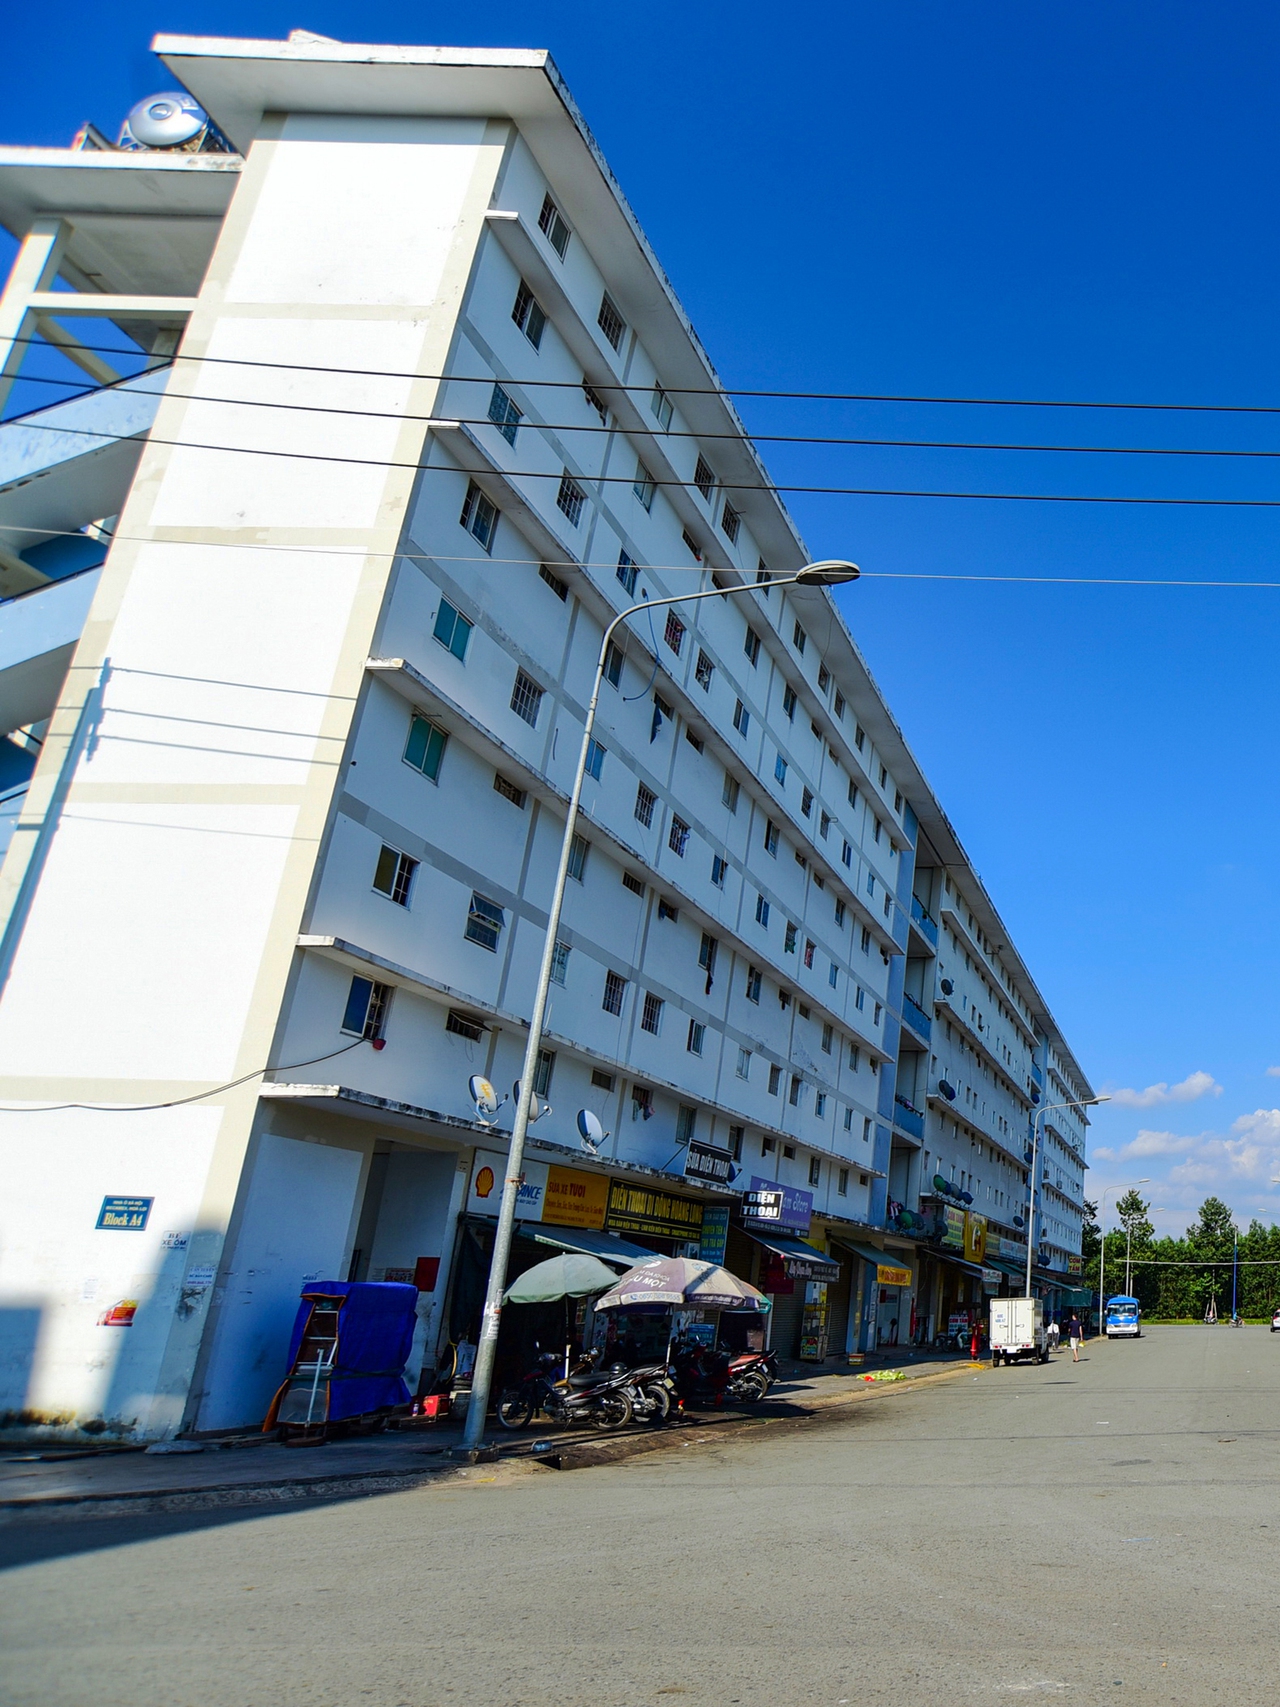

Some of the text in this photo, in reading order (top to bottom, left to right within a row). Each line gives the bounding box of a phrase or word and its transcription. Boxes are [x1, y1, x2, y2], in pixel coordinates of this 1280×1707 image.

[699, 1154, 714, 1175] ĐIỆN
[560, 1184, 568, 1195] XE
[611, 1184, 628, 1213] ĐIỆN
[628, 1190, 648, 1217] THOẠI
[646, 1194, 655, 1215] DI
[654, 1193, 671, 1220] ĐỘNG
[743, 1206, 778, 1218] THOẠI
[102, 1212, 143, 1226] Block A4
[654, 1272, 670, 1282] KHOA
